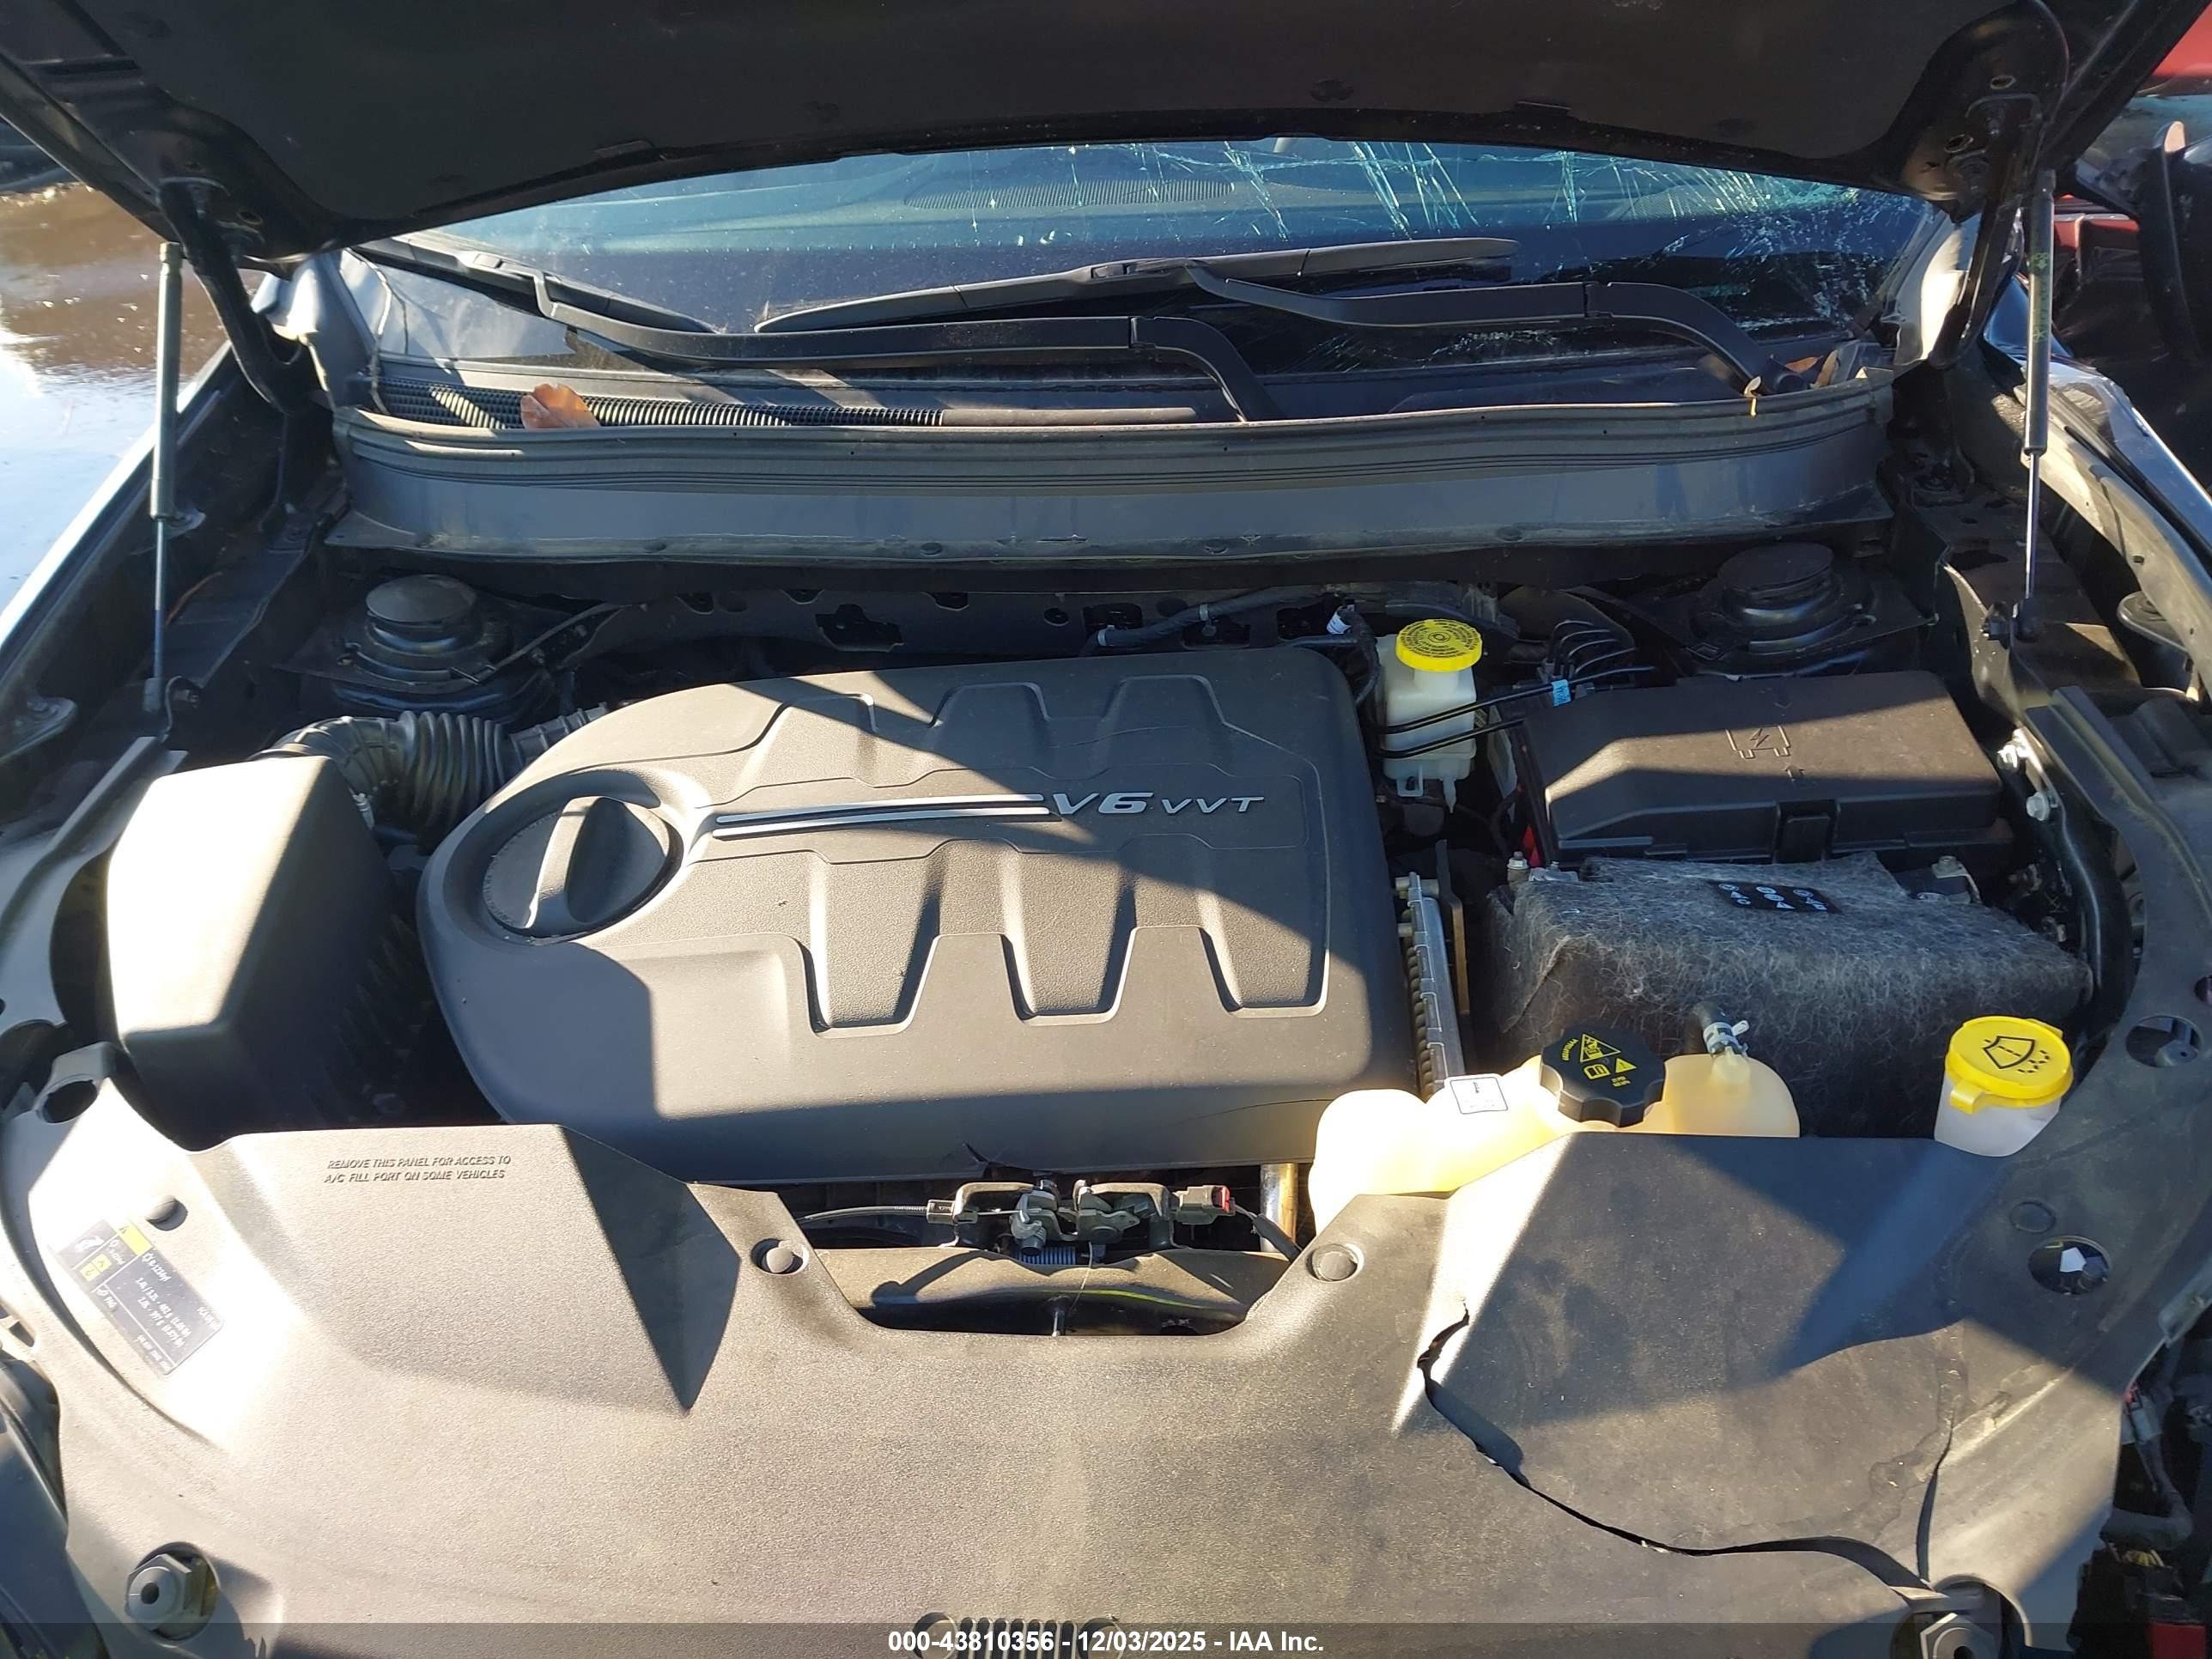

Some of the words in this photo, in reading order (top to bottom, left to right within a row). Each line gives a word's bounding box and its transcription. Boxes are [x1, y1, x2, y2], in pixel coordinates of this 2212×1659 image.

[1053, 792, 1154, 815] V6
[1161, 796, 1265, 814] VVT
[327, 1159, 370, 1169] REMOVE
[373, 1158, 396, 1168] THIS
[397, 1158, 430, 1167] PANEL
[432, 1157, 453, 1166] FOR
[456, 1156, 495, 1165] ACCESS
[498, 1155, 512, 1164] TO
[324, 1174, 345, 1182] A/C
[349, 1173, 370, 1182] FILL
[373, 1172, 401, 1182] PORT
[404, 1171, 421, 1180] ON
[422, 1170, 453, 1180] SOME
[456, 1170, 506, 1179] VEHICLES
